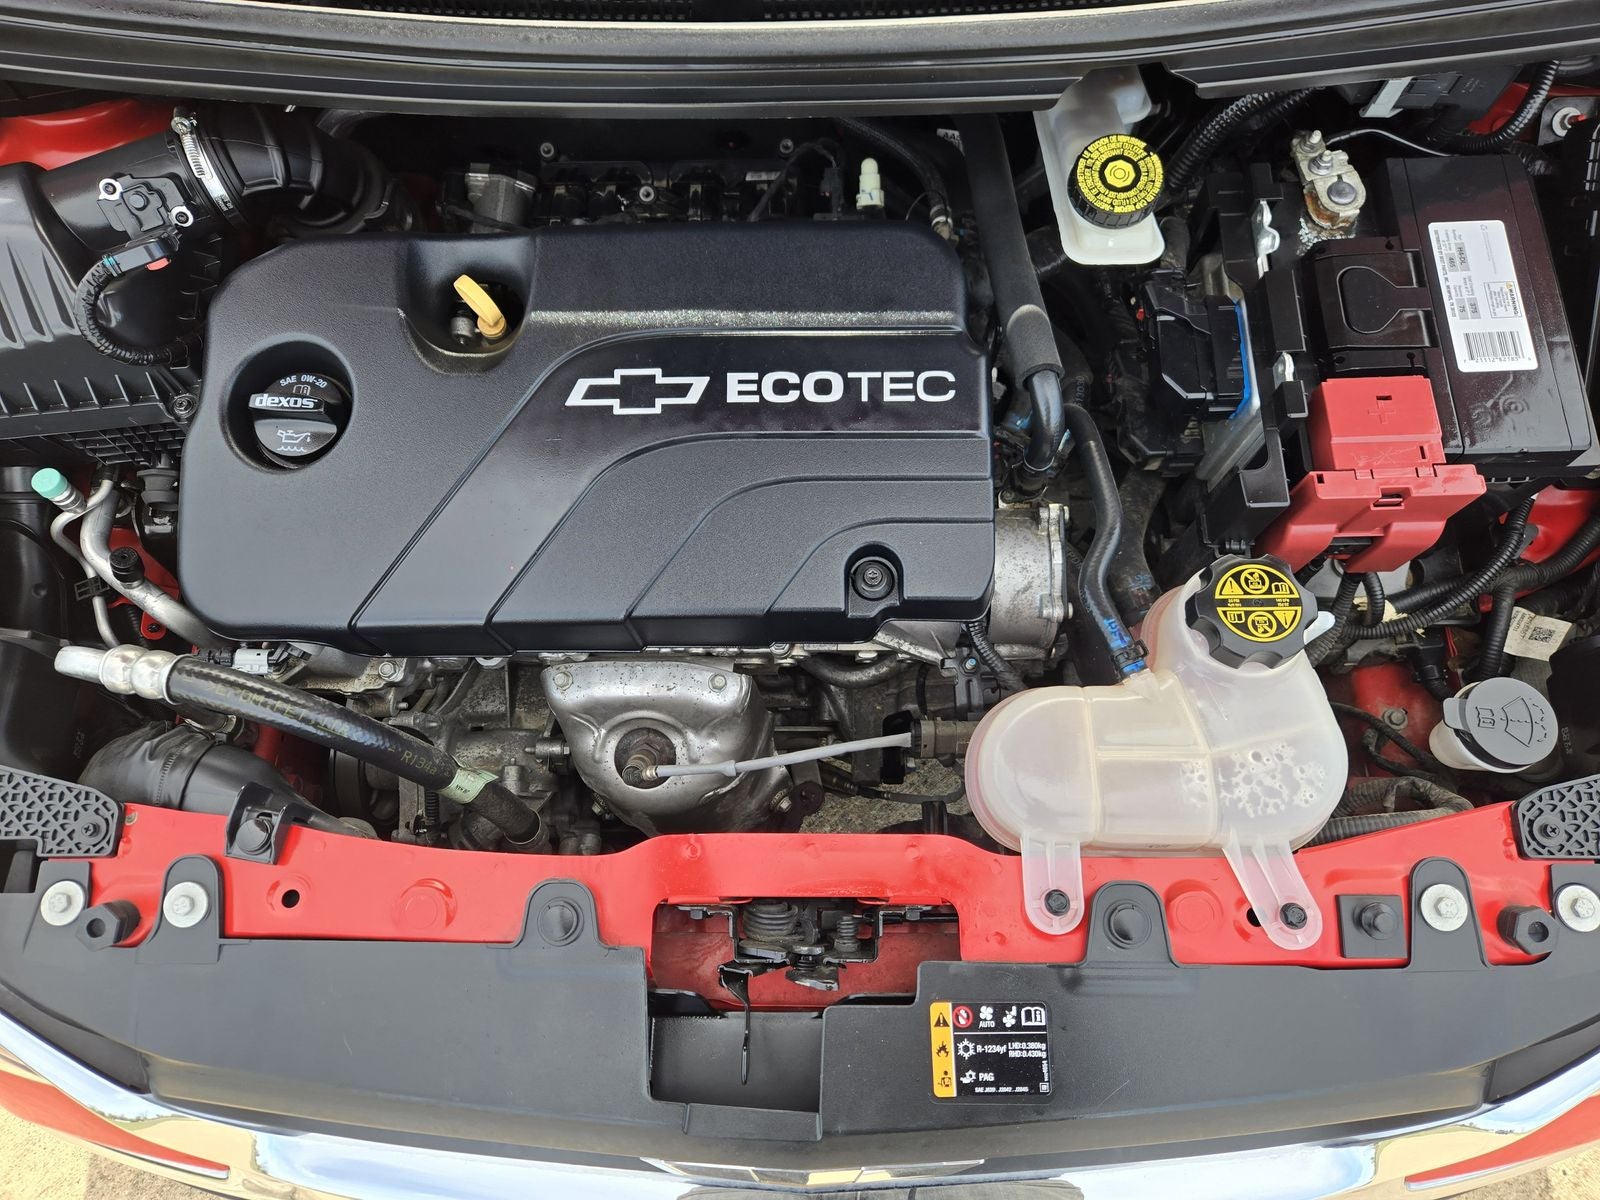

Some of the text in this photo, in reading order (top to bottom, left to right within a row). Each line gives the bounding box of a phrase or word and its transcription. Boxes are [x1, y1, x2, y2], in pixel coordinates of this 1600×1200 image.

[1469, 302, 1478, 314] 375
[280, 375, 328, 388] SAE 0W-20
[726, 370, 956, 402] ECOTEC
[255, 394, 318, 408] dexos
[400, 750, 437, 775] R134a
[977, 1045, 1007, 1054] R-1234yf
[979, 1073, 995, 1081] PAG
